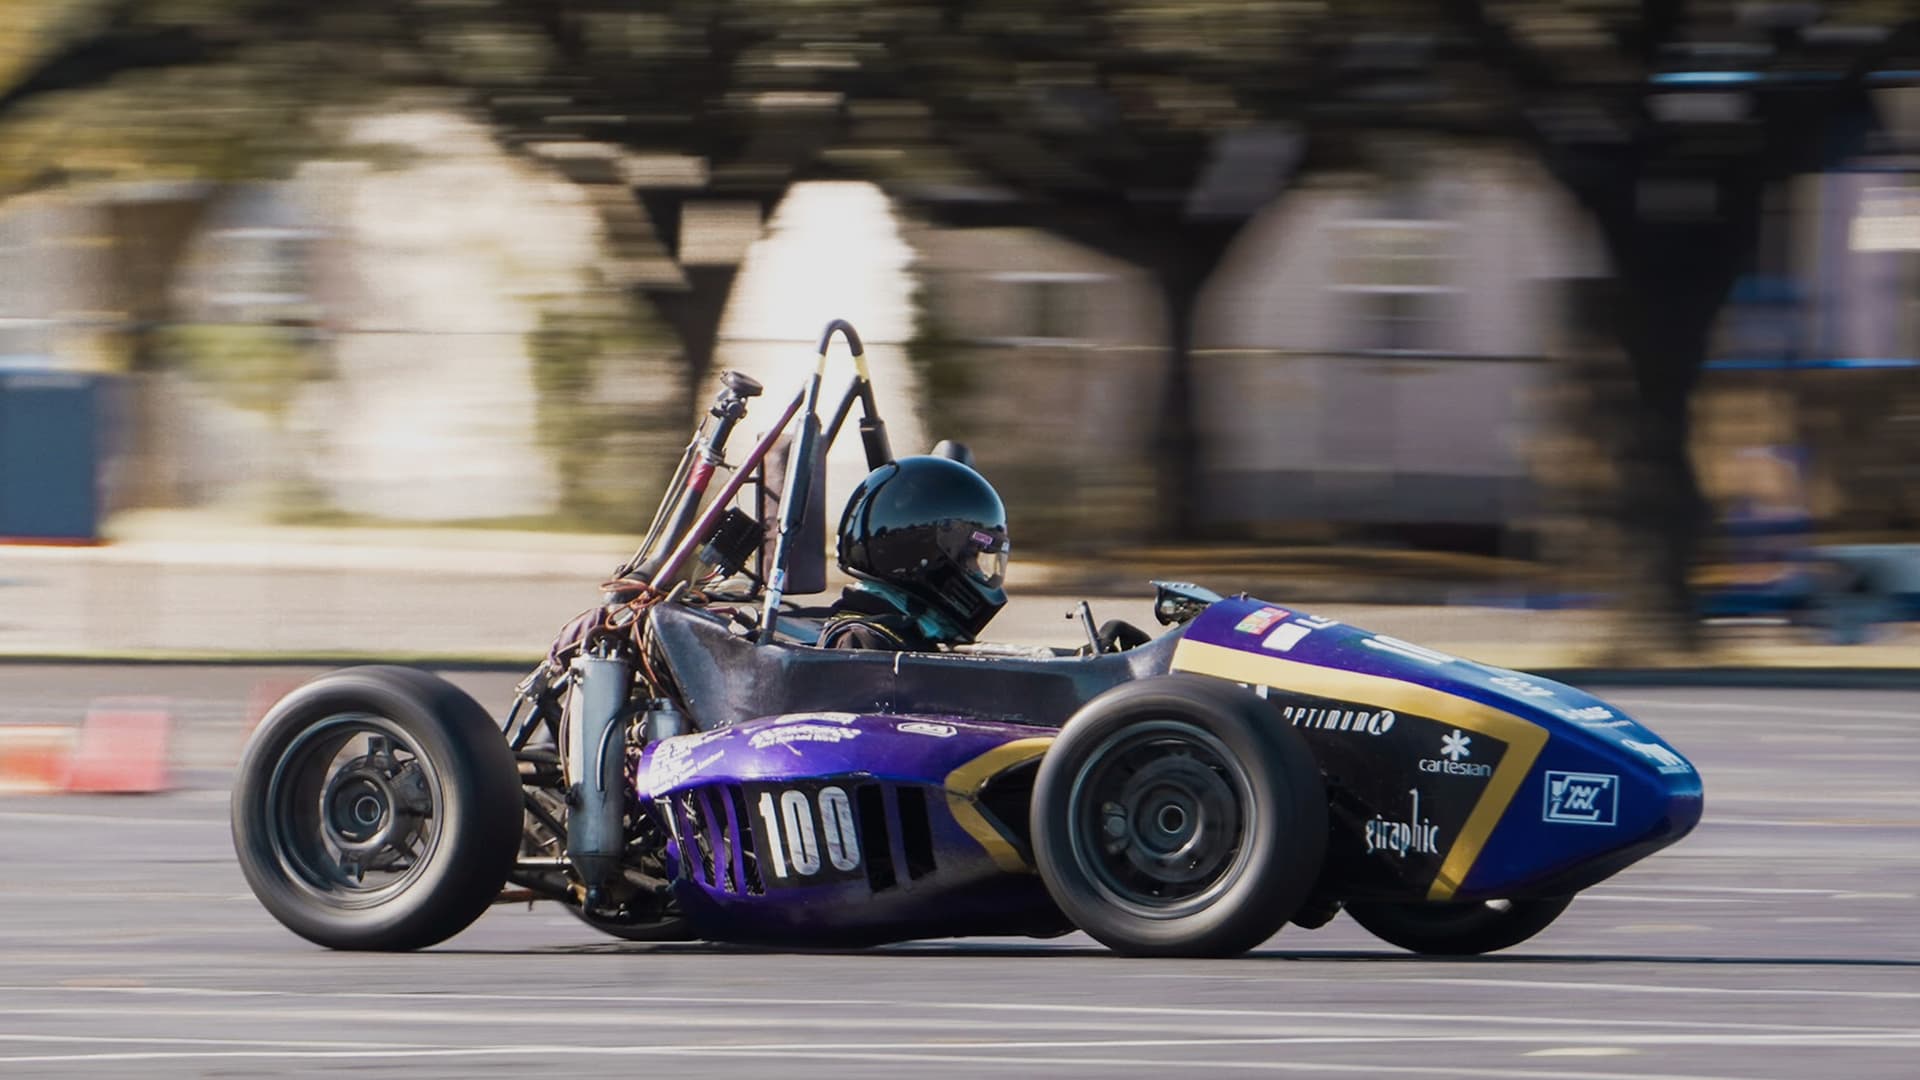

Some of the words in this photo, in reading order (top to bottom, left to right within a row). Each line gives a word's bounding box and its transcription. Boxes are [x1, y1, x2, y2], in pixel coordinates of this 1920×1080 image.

[1418, 759, 1492, 777] cartesian
[758, 785, 861, 879] 100
[1365, 788, 1439, 859] giraphic
